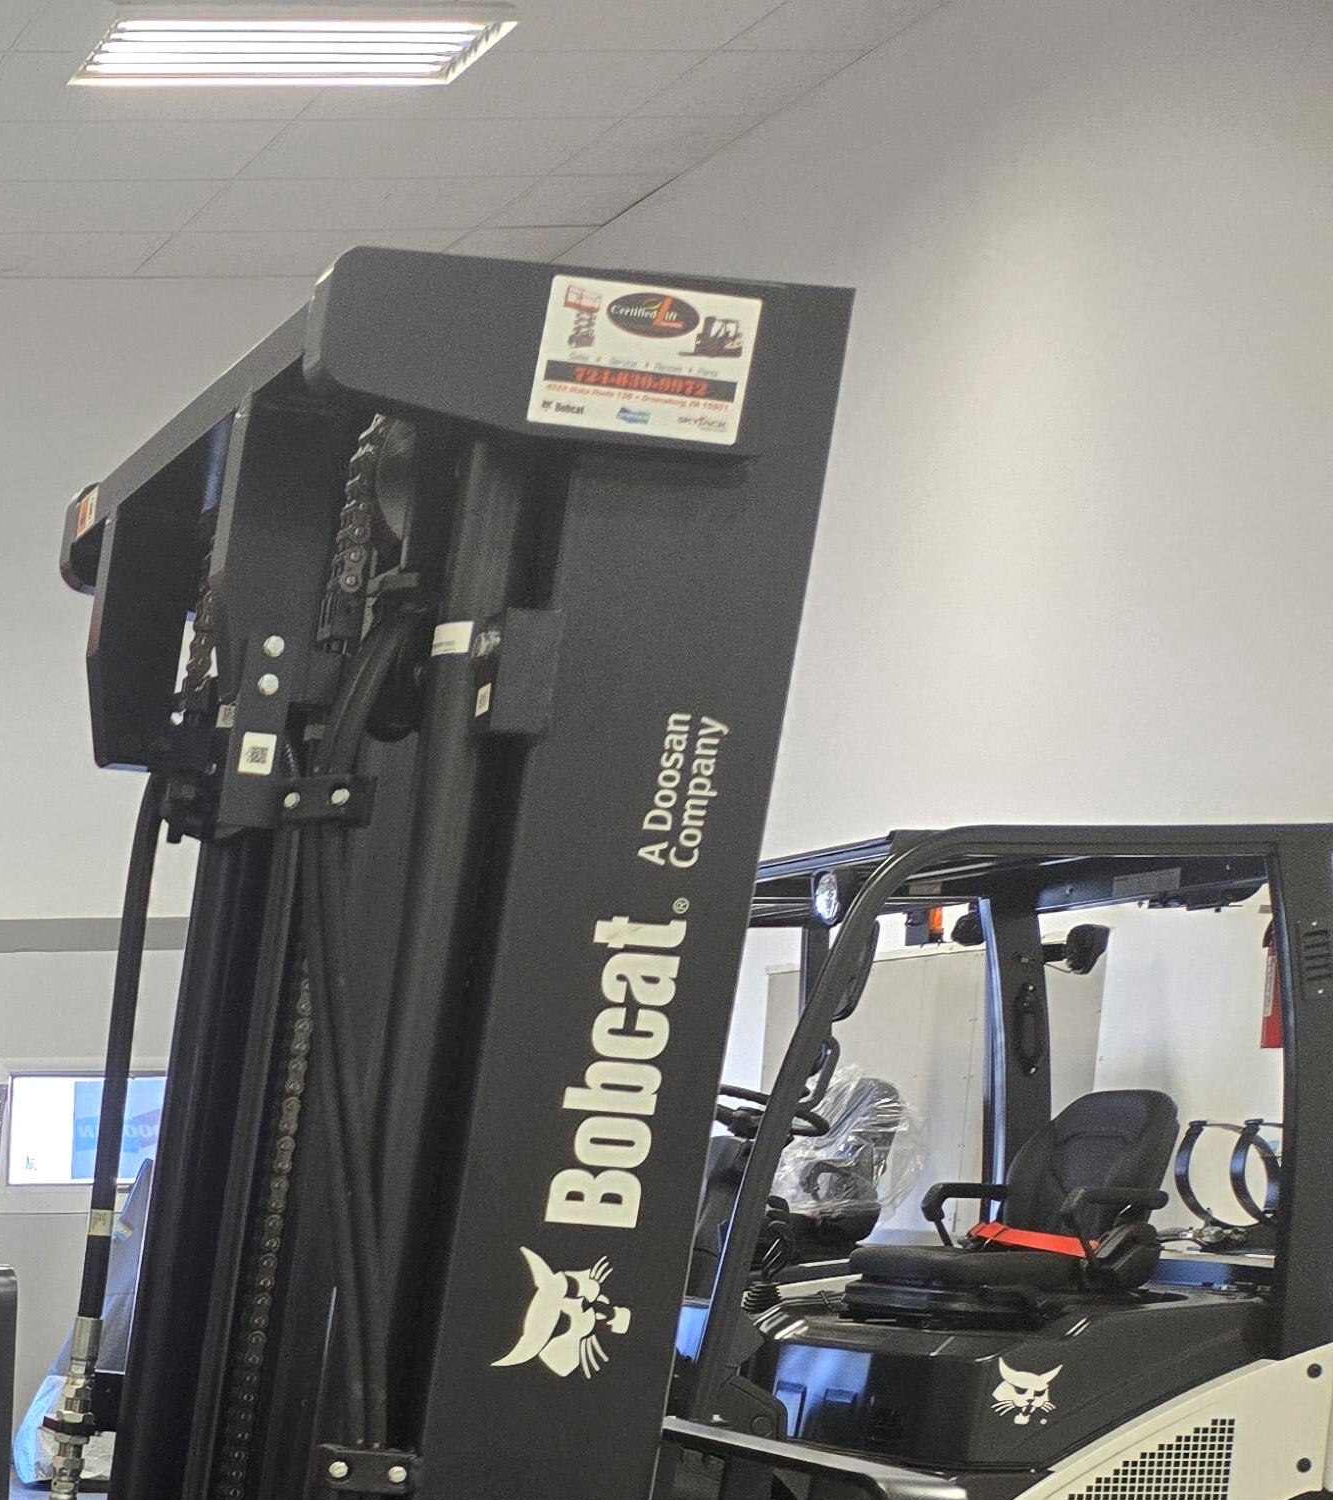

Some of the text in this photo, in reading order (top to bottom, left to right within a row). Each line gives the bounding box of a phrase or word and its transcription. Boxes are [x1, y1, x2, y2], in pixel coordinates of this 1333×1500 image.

[637, 712, 692, 866] A Doosan
[669, 715, 730, 868] Company
